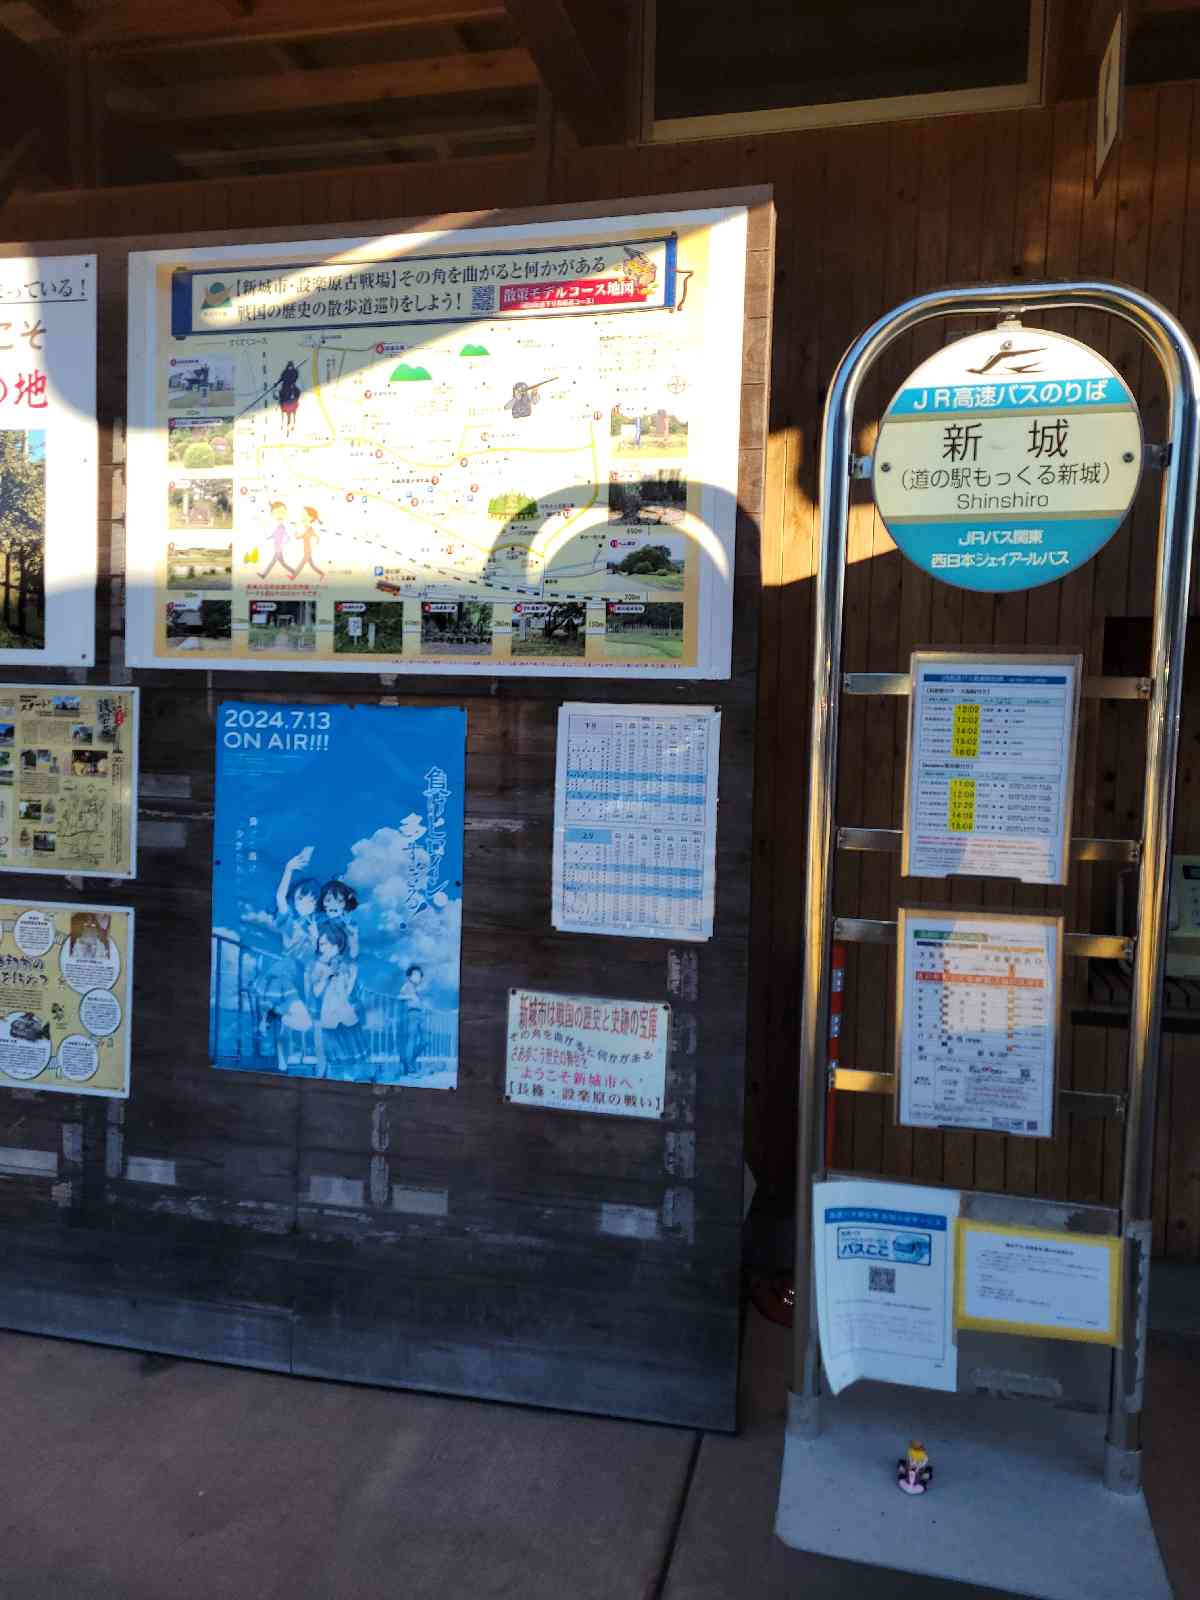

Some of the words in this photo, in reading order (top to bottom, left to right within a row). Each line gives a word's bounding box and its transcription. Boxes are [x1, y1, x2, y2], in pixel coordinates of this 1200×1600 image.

[913, 379, 1107, 410] JR高速バスのりば
[956, 491, 1049, 510] Shinshiro
[958, 528, 1043, 546] JRバス関東
[931, 550, 1070, 568] 西日本ジェイアールバス
[224, 709, 331, 730] 2024.7.13
[223, 731, 261, 749] ON
[268, 733, 329, 751] AIR!!!
